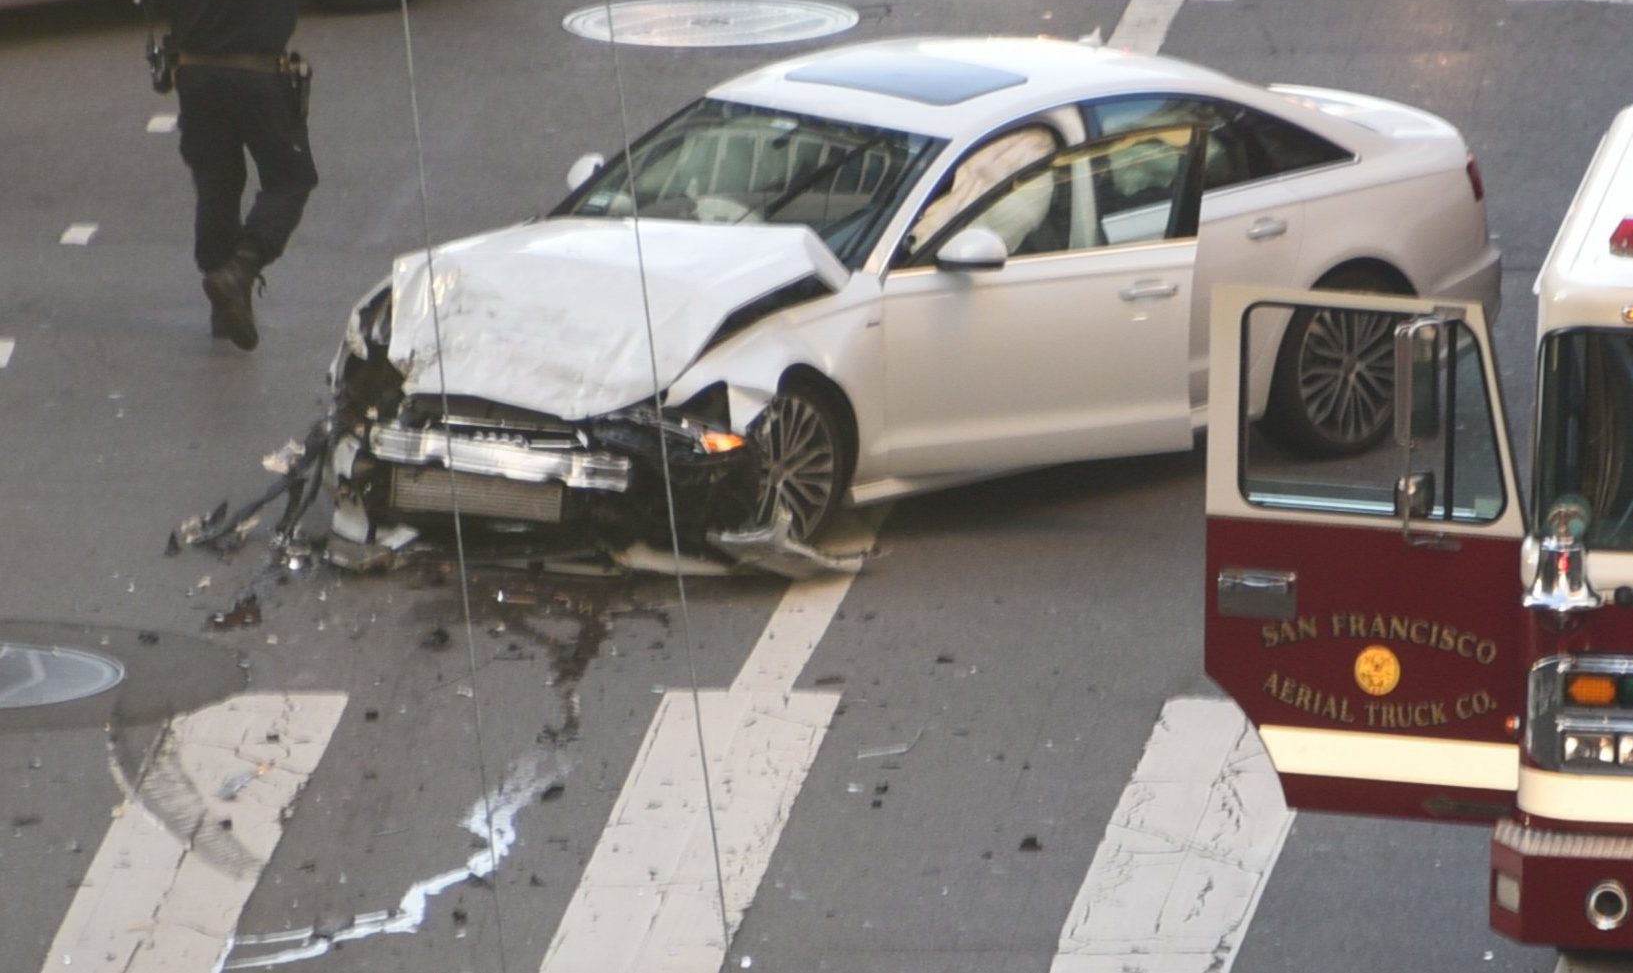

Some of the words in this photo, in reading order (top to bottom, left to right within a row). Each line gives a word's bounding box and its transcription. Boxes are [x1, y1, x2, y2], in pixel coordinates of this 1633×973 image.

[1262, 615, 1317, 648] SAN
[1332, 612, 1497, 665] FRANCISCO
[1262, 670, 1354, 724] AERIAL
[1364, 699, 1448, 729] TRUCK
[1455, 688, 1498, 720] CO.
